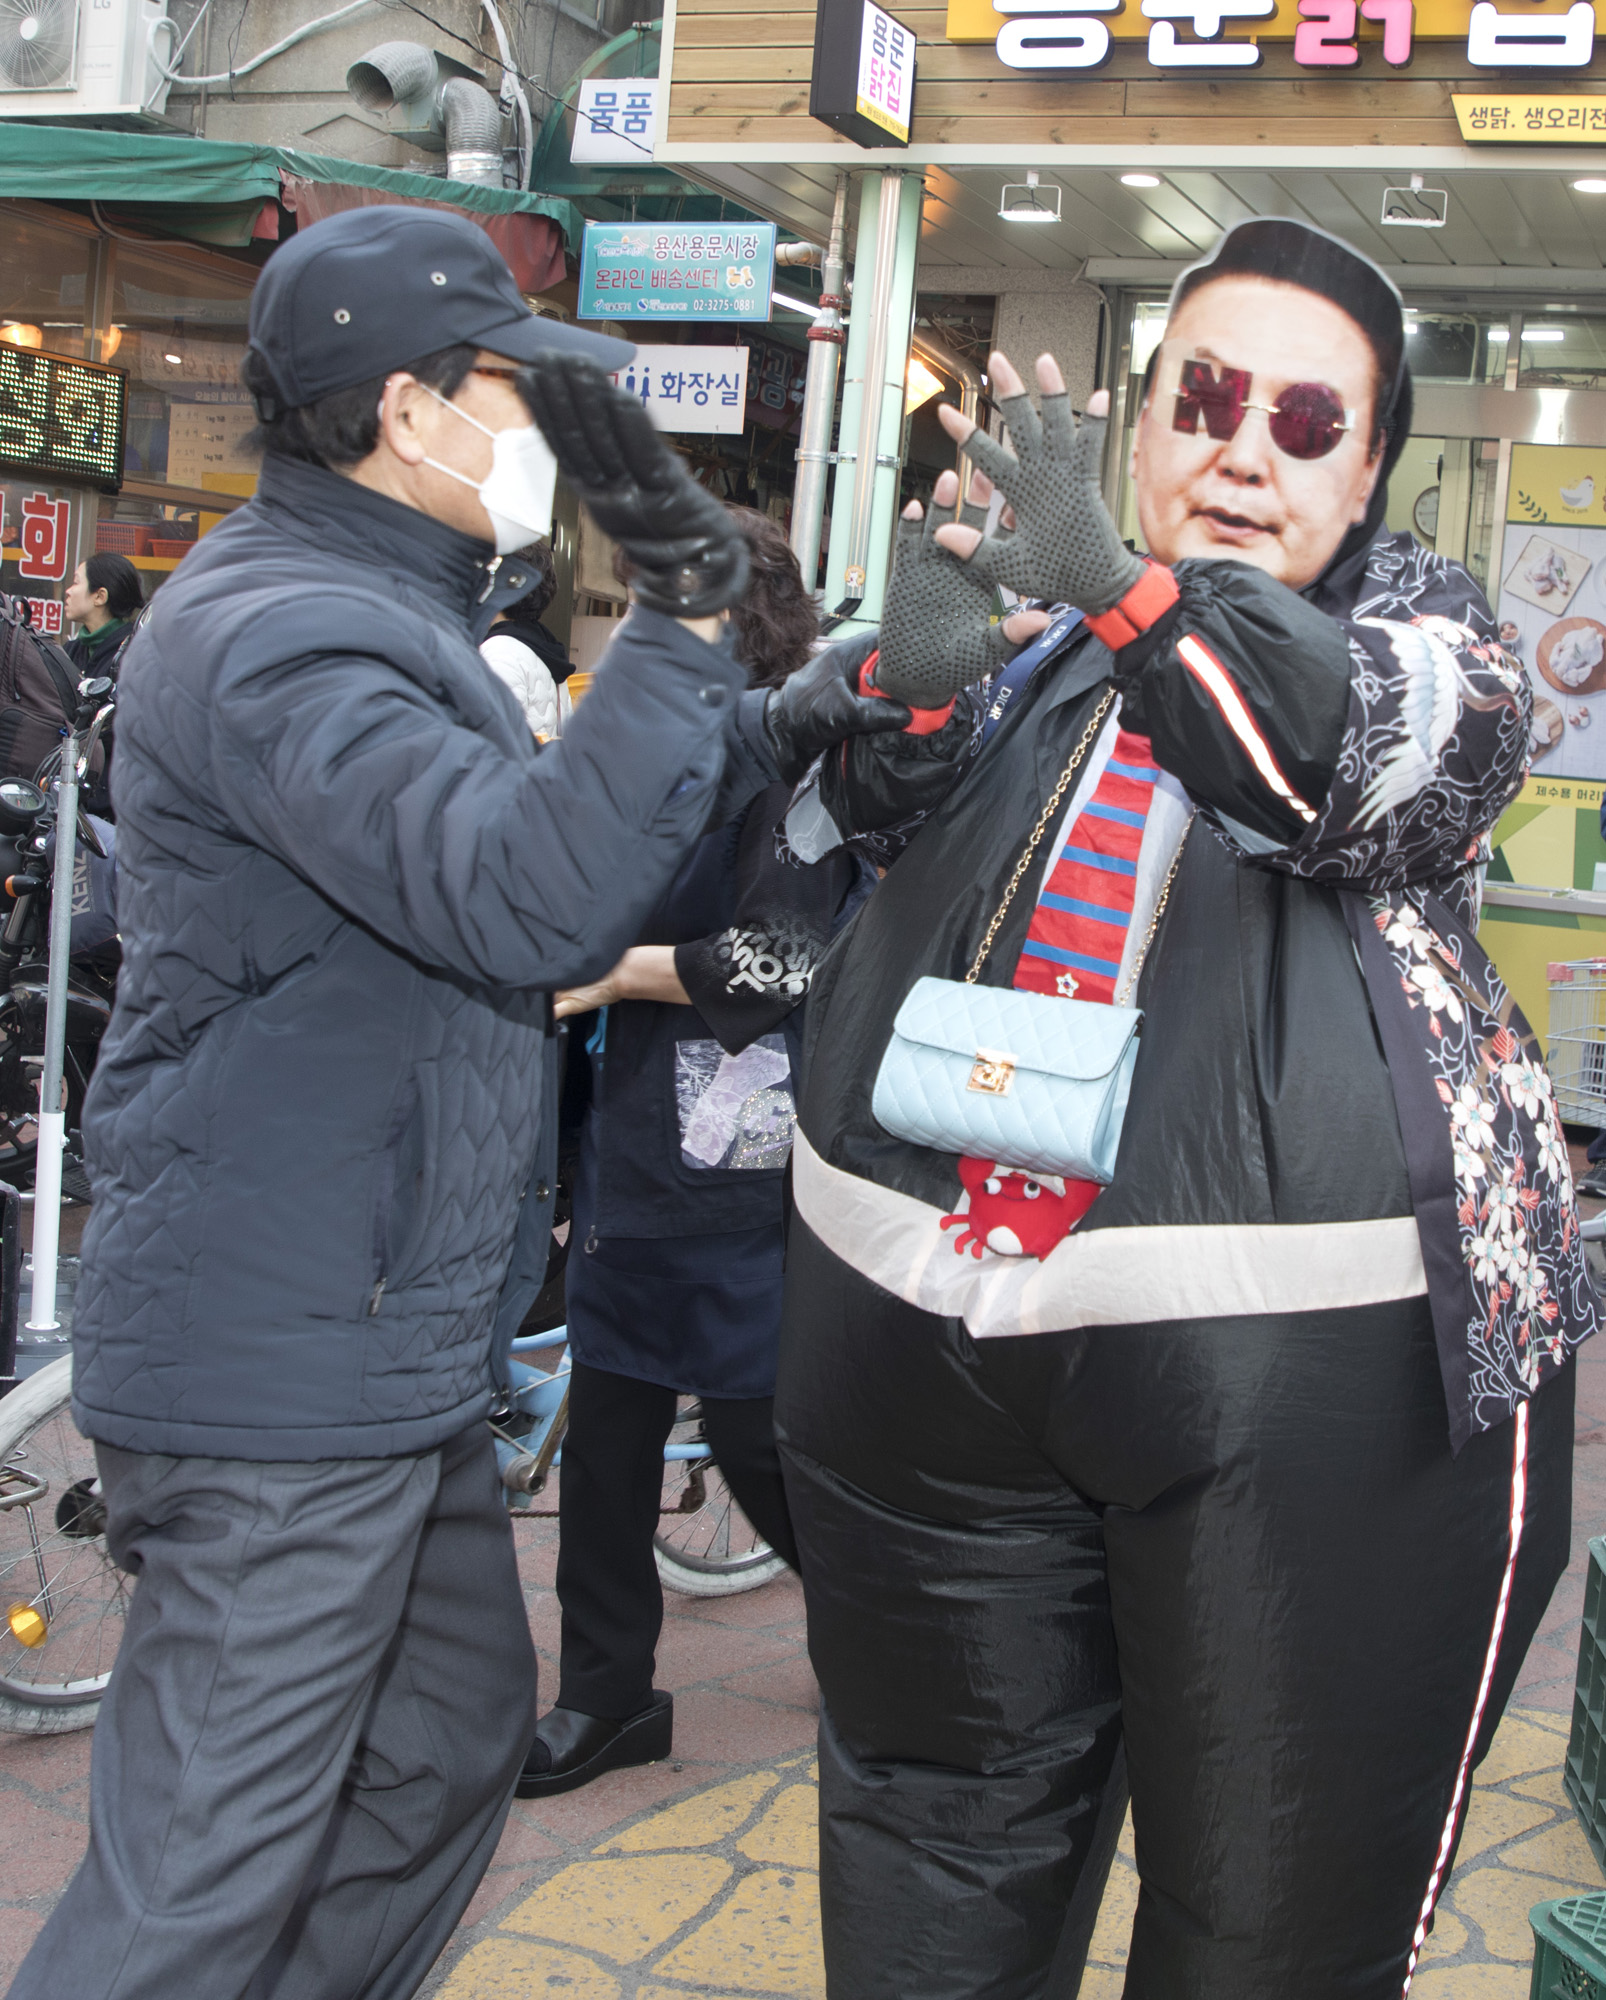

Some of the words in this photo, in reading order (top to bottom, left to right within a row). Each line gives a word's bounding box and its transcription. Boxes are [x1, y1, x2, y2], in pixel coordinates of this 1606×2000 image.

[94, 0, 111, 9] LG
[873, 13, 904, 71] 용문
[868, 56, 902, 114] 닭집
[589, 92, 653, 133] 물품
[1469, 107, 1515, 129] 생닭.
[655, 235, 759, 260] 용산용문시장
[595, 269, 645, 290] 온라인
[651, 268, 719, 289] 배송센터
[693, 299, 755, 311] 02-3275-0881
[659, 371, 740, 406] 화장실
[0, 491, 70, 581] 회
[988, 686, 1012, 720] DIOR
[71, 850, 91, 917] KENZ
